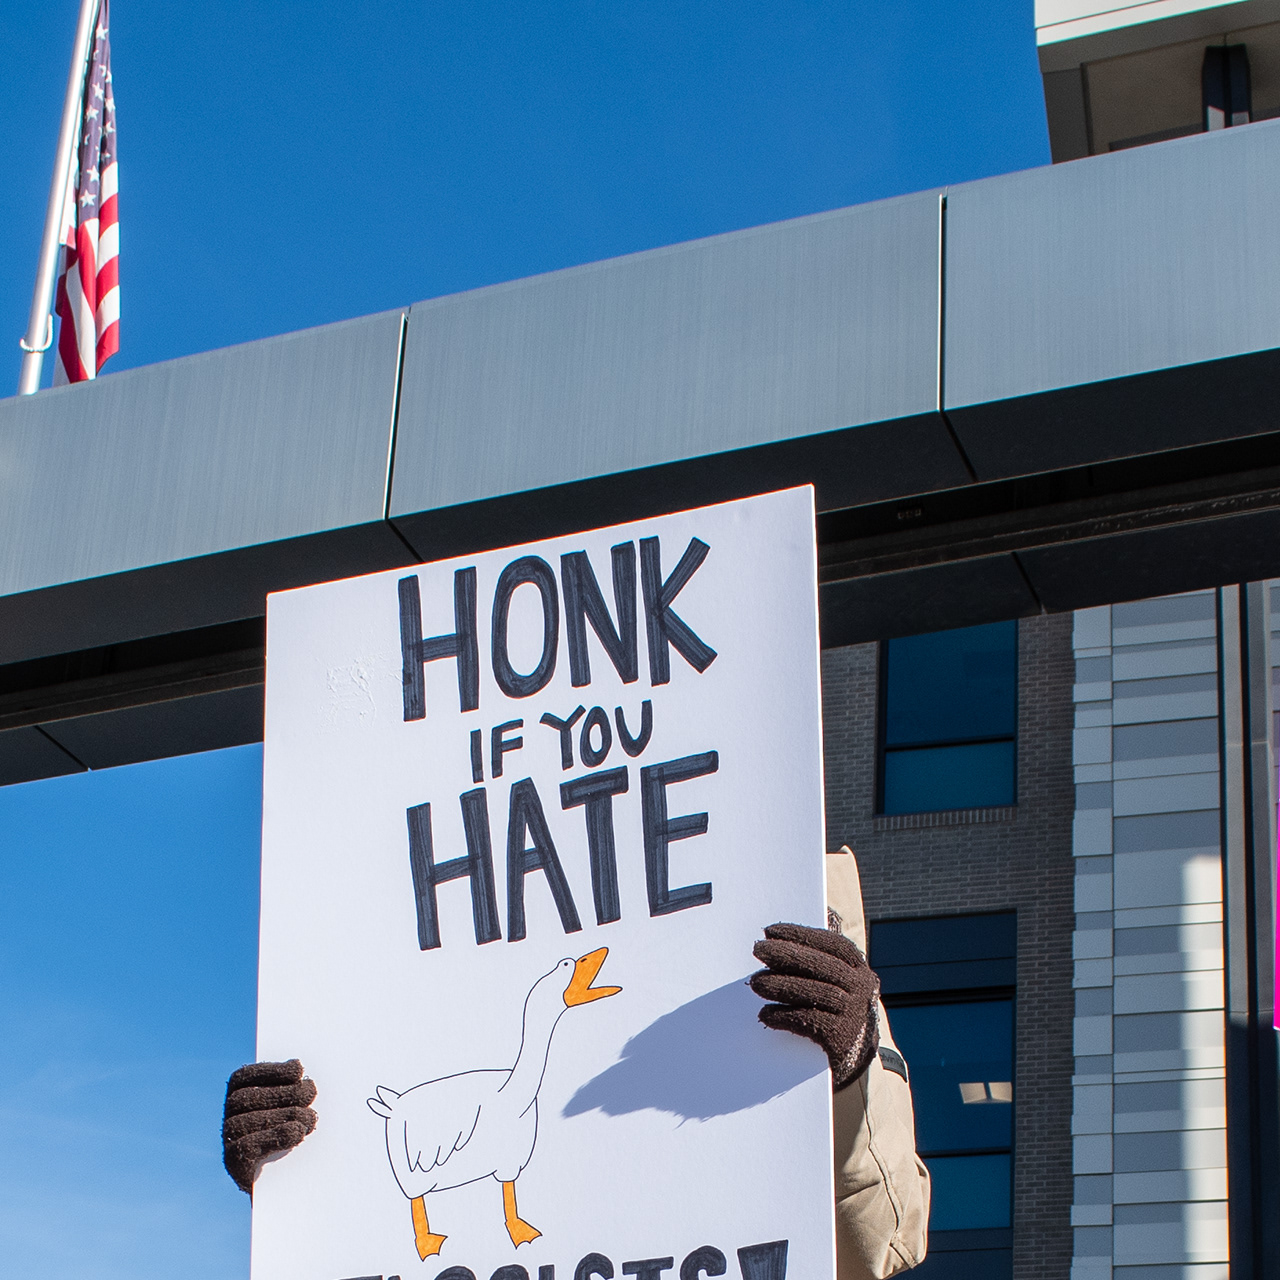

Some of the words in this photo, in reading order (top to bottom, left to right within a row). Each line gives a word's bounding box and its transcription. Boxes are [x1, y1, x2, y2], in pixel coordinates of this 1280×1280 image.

[398, 535, 718, 721] HONK
[470, 719, 523, 783] IF
[540, 700, 652, 770] YOU
[406, 750, 719, 950] HATE
